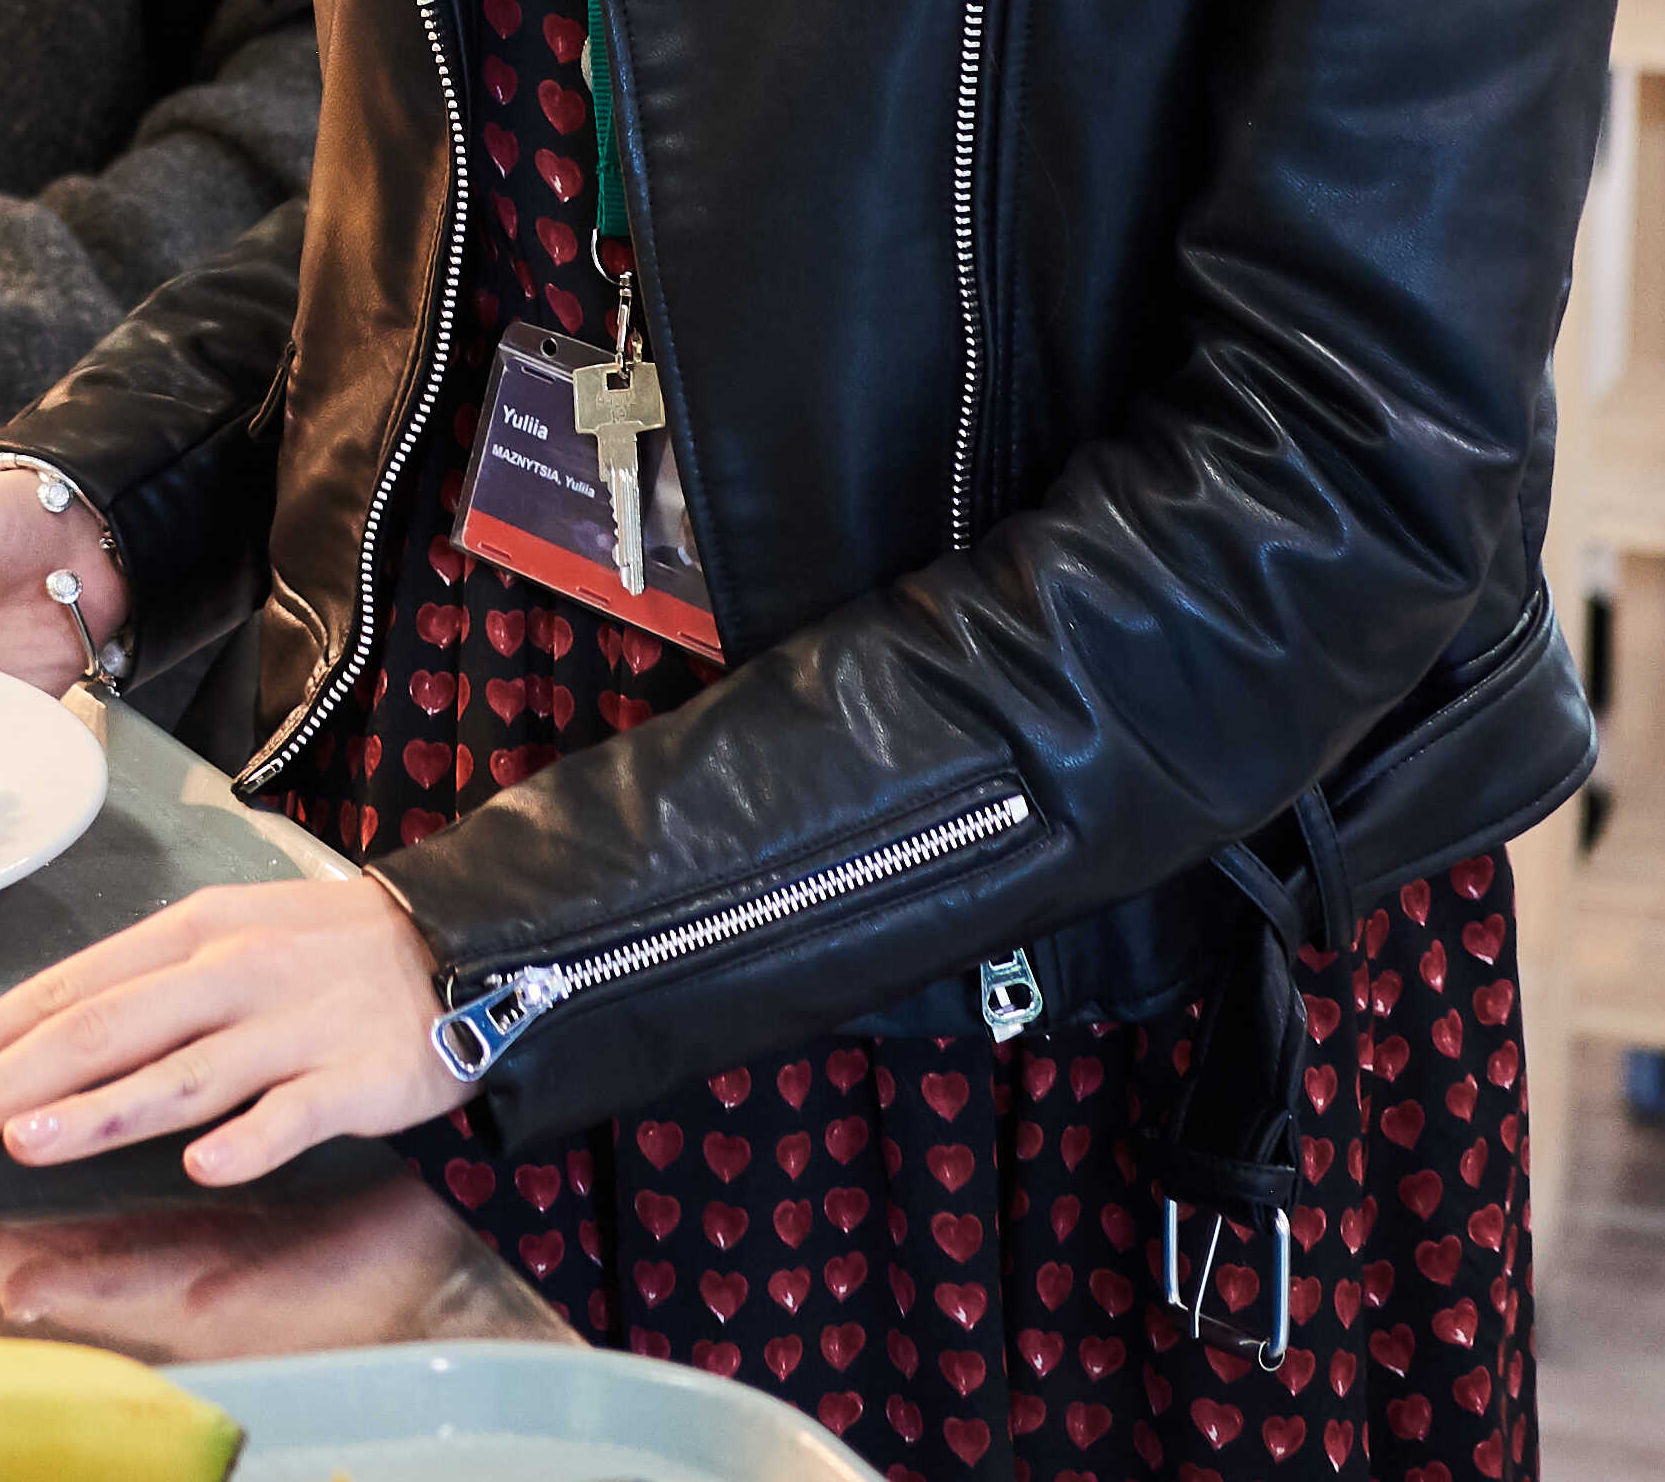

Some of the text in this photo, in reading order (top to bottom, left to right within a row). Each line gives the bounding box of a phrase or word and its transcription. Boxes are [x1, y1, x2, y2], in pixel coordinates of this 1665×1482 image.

[503, 404, 549, 440] Yuliia
[491, 443, 596, 498] MAZNYTSIA, Yuliia
